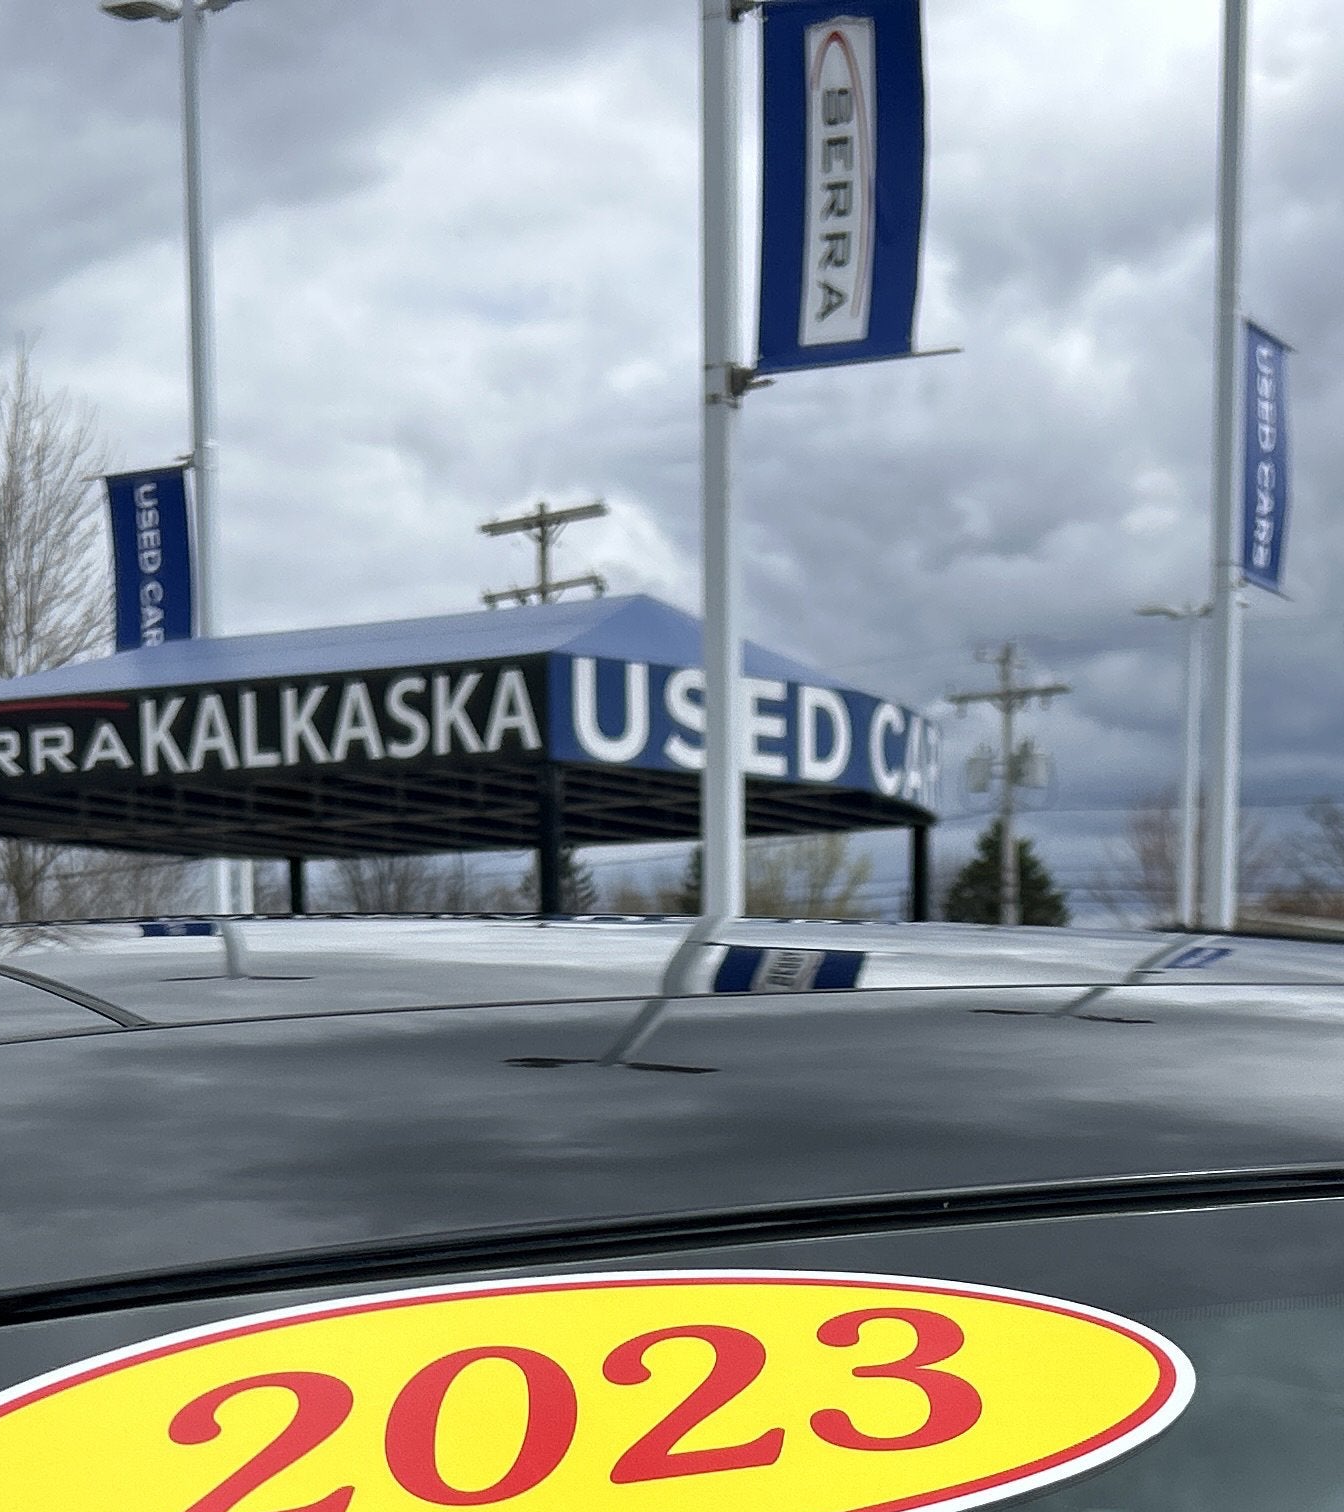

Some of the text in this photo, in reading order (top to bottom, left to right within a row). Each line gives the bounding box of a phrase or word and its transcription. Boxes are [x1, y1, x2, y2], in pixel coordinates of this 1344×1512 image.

[815, 86, 855, 323] SERRA
[134, 481, 163, 574] USED
[140, 665, 543, 775] KALKASKA
[571, 656, 854, 784] USED
